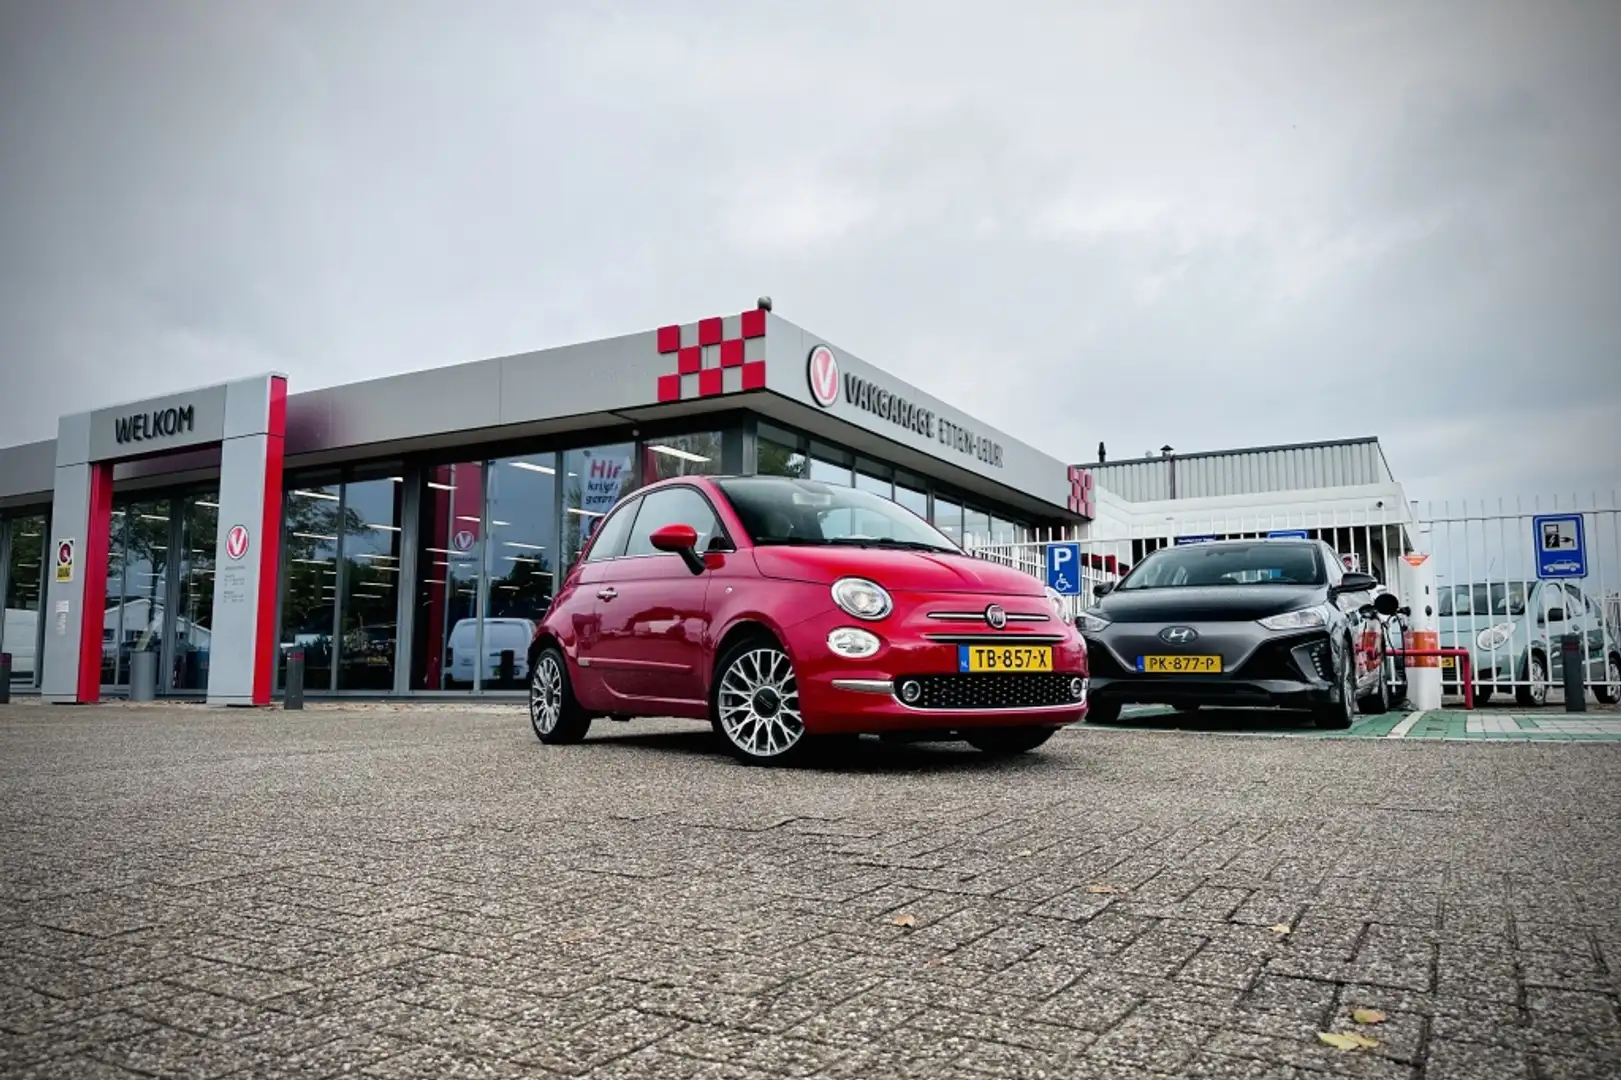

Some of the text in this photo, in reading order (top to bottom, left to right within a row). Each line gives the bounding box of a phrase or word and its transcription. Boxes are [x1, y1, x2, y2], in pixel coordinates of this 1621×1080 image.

[115, 404, 194, 444] WELKOM
[844, 372, 1003, 469] VAKGARAGE ETTEN-LEUR
[1054, 547, 1072, 571] P
[975, 649, 1047, 668] TB-857-X
[1149, 657, 1215, 670] PK-877-P
